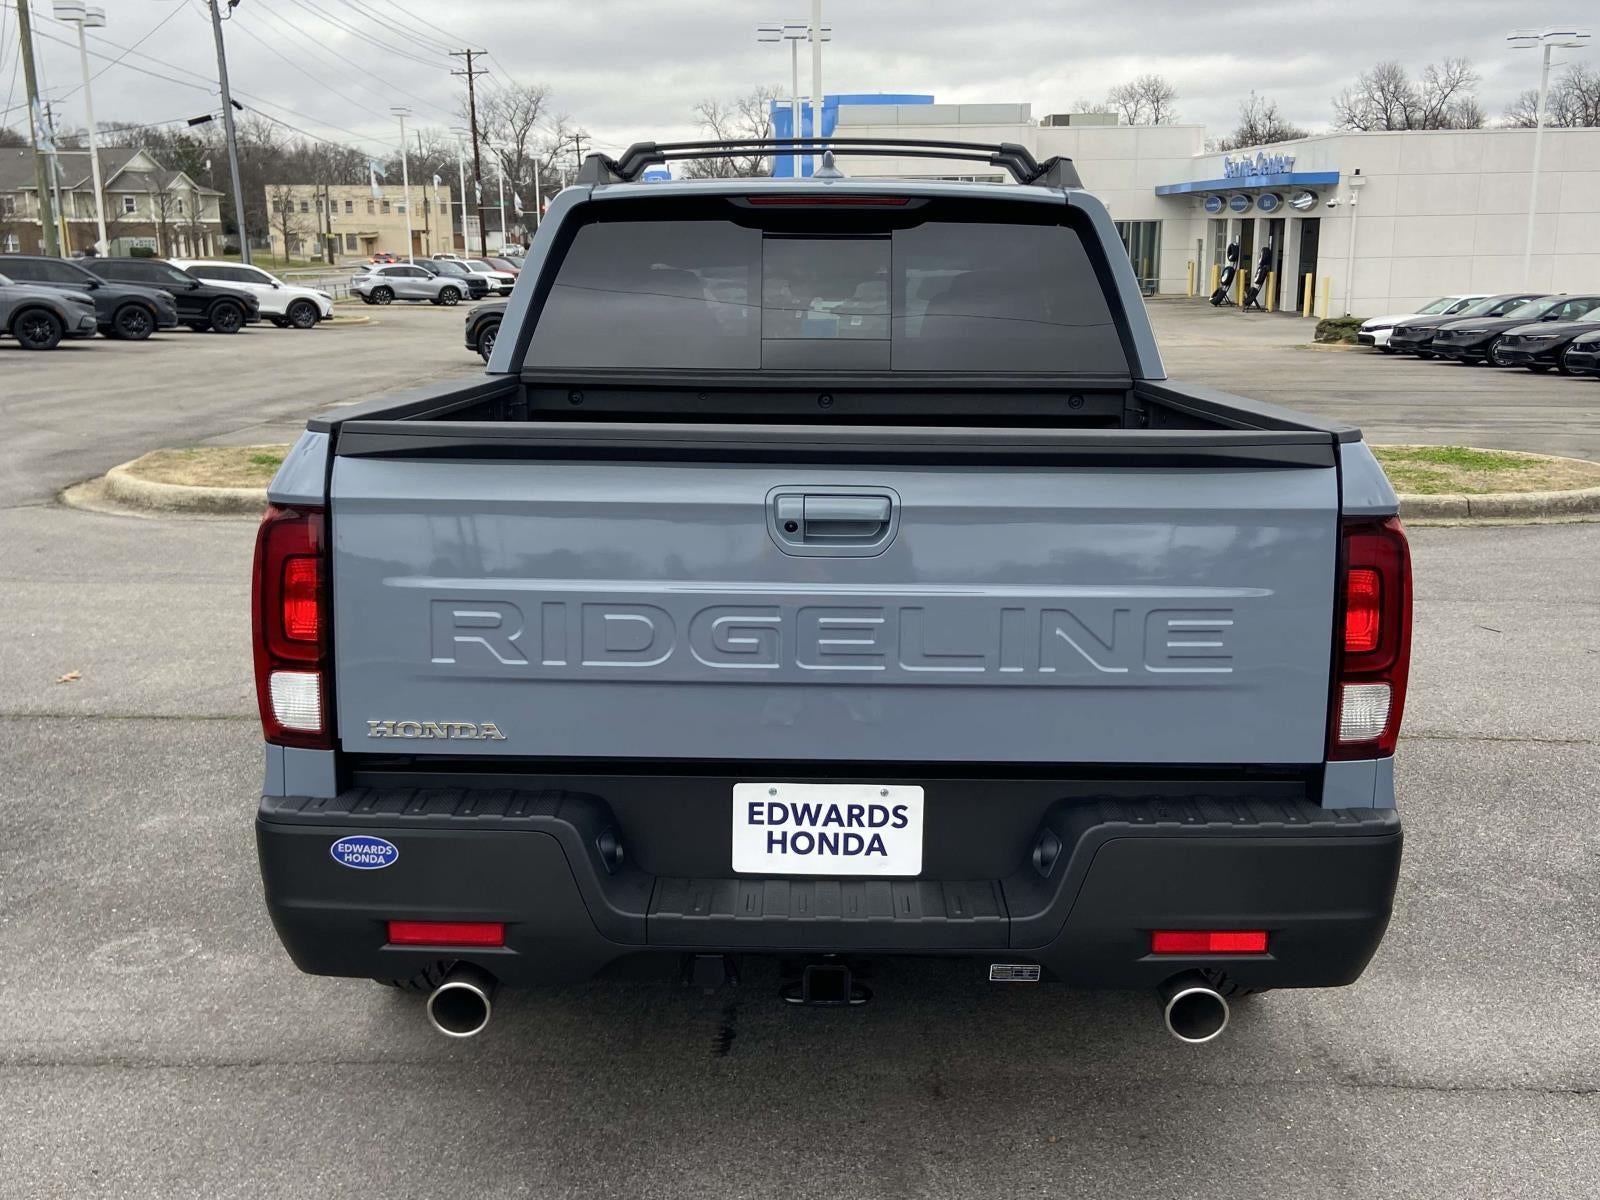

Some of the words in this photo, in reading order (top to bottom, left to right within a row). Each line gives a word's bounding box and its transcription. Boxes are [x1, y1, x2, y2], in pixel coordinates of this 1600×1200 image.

[430, 599, 1234, 673] RIDGELINE
[367, 720, 508, 740] HONDA
[748, 801, 909, 829] EDWARDS
[338, 843, 393, 855] EDWARDS
[767, 830, 888, 857] HONDA
[344, 853, 386, 864] HONDA
